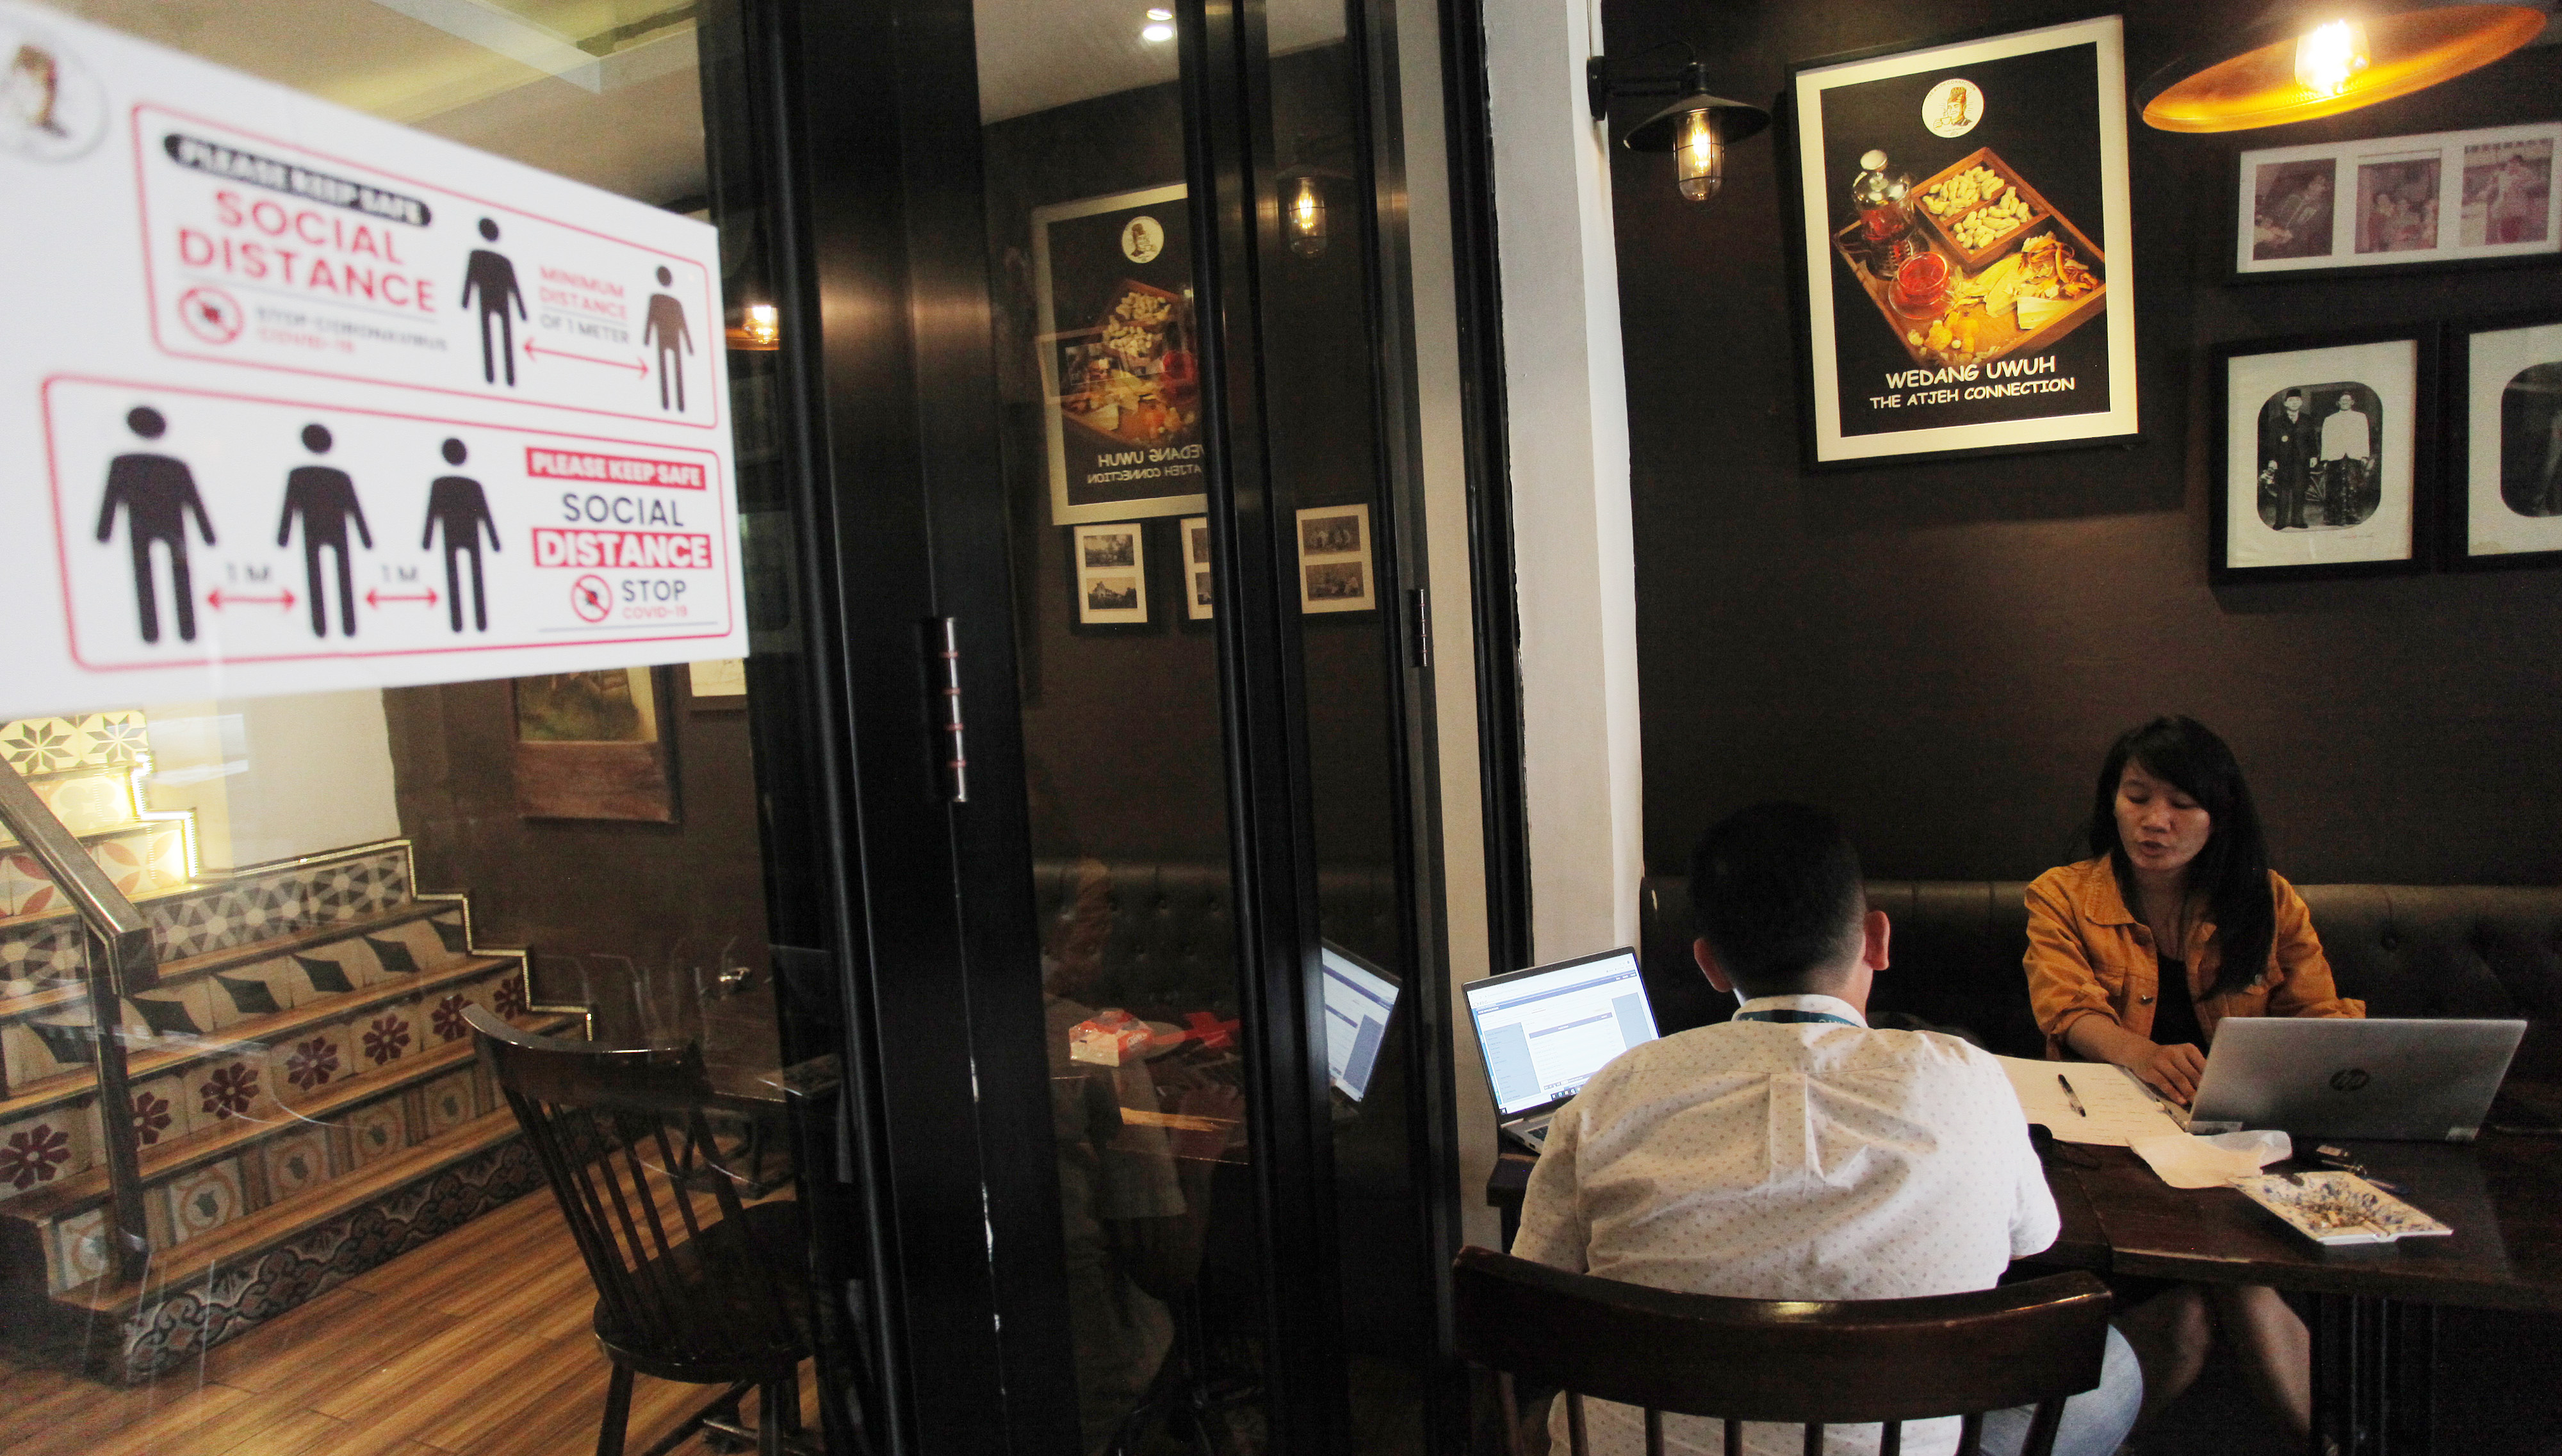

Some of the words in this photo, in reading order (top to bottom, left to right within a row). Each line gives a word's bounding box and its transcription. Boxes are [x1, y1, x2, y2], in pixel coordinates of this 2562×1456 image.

[178, 139, 286, 191] PLEASE
[290, 168, 357, 208] KEEP
[361, 189, 423, 225] SAFE
[216, 190, 405, 266] SOCIAL
[178, 226, 436, 313] DISTANCE
[540, 264, 625, 298] MINIMUM
[539, 286, 628, 321] DISTANCE
[540, 312, 562, 330] OF
[567, 318, 575, 334] 1
[577, 321, 630, 344] METER
[1886, 364, 1980, 389] WEDANG
[1986, 355, 2057, 380] UWUH
[1870, 394, 1902, 410] THE
[1907, 388, 1960, 407] ATJEH
[1964, 376, 2076, 401] CONNECTION
[532, 451, 606, 479] PLEASE
[610, 459, 656, 482] KEEP
[658, 463, 701, 487] SAFE
[562, 492, 683, 526] SOCIAL
[536, 530, 708, 567] DISTANCE
[245, 562, 270, 585] M
[396, 563, 418, 584] M
[621, 579, 687, 603] STOP
[622, 605, 689, 620] COVID-19
